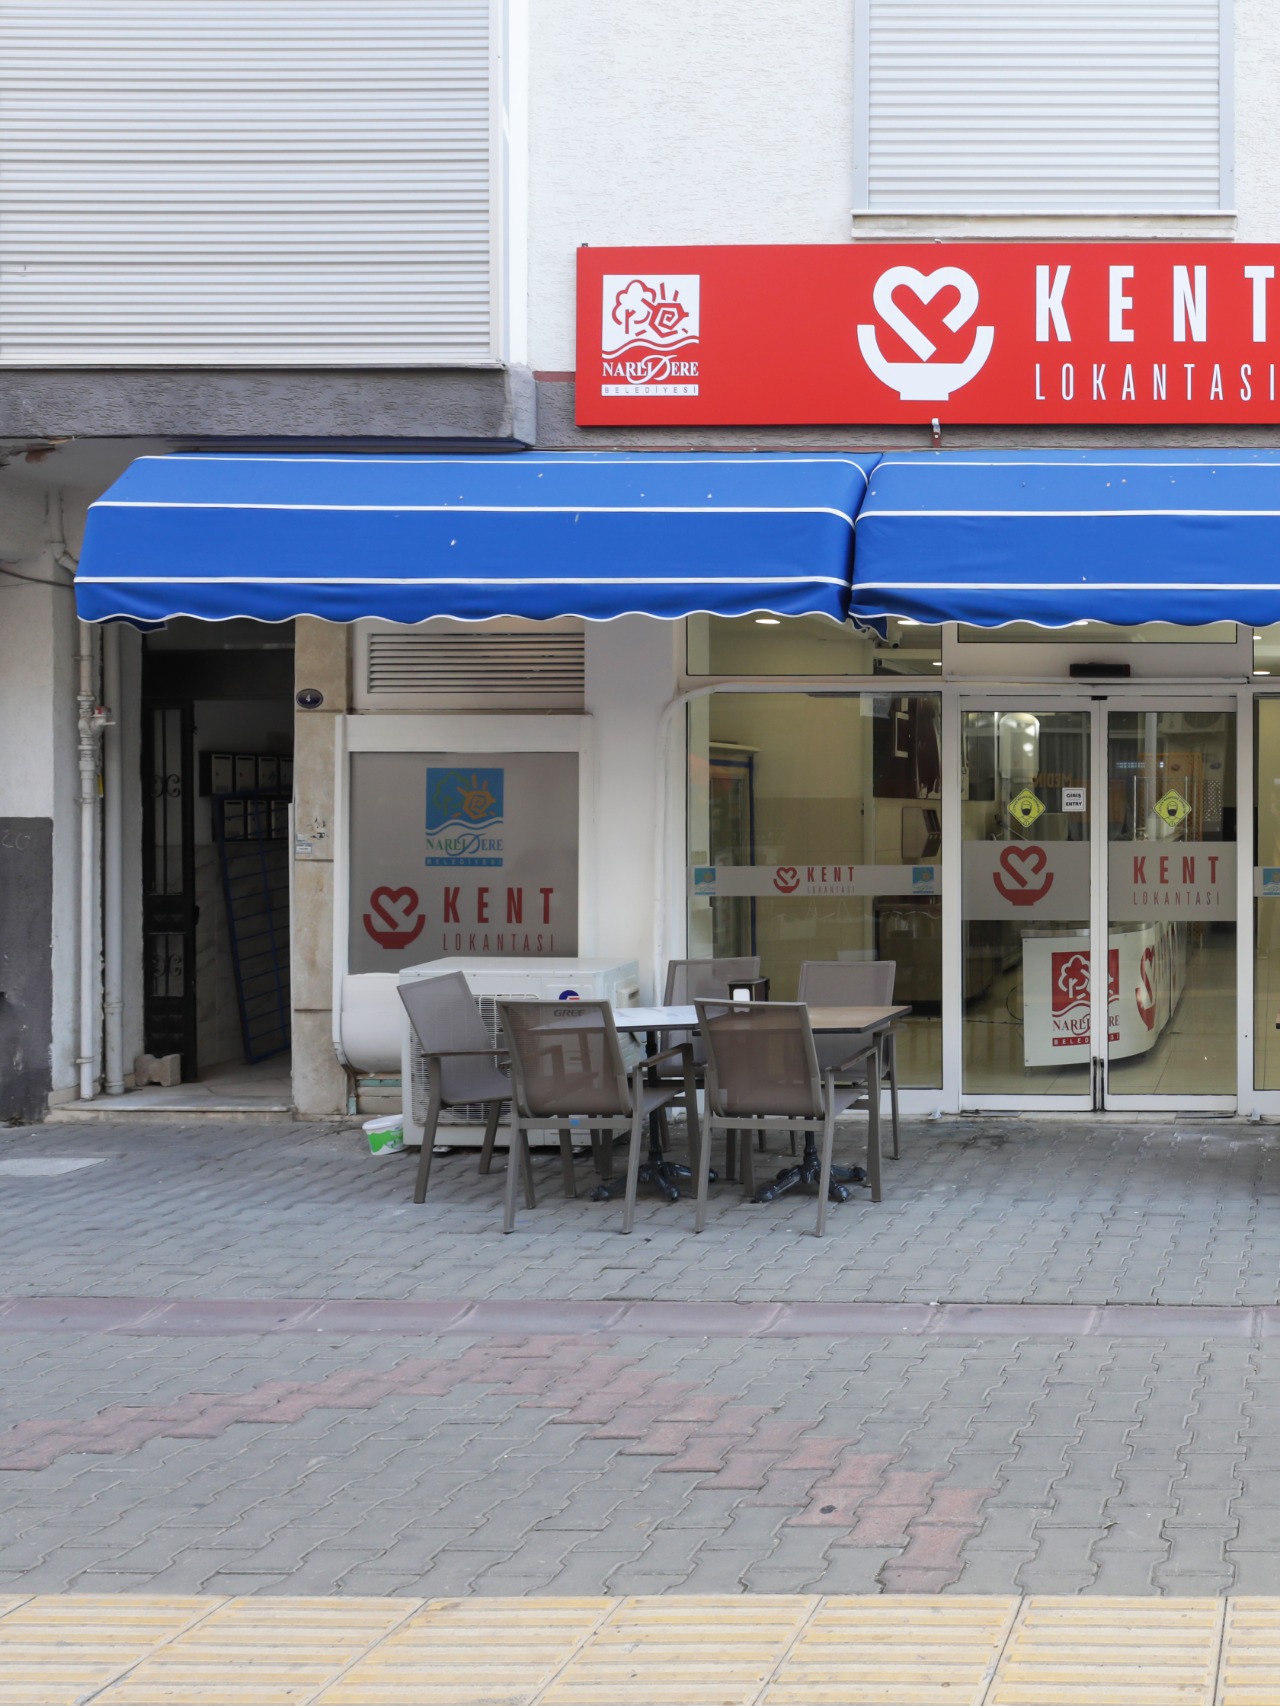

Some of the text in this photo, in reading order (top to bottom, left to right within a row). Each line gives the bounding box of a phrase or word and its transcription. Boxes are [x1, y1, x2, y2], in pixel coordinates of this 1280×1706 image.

[1035, 264, 1275, 343] KENT
[602, 354, 699, 384] NARLIDERE
[603, 386, 697, 394] BELEDİYESİ
[1035, 363, 1275, 401] LOKANTASI
[305, 693, 312, 703] 4
[426, 833, 504, 856] NARLIDERE
[807, 866, 854, 882] KENT
[1133, 856, 1219, 884] KENT
[443, 886, 554, 924] KENT
[1133, 891, 1220, 905] LOKANTASI
[443, 933, 554, 952] LOKANTASI
[1053, 1014, 1119, 1035] NARLIRE
[1054, 1034, 1119, 1045] BELEDSİ
